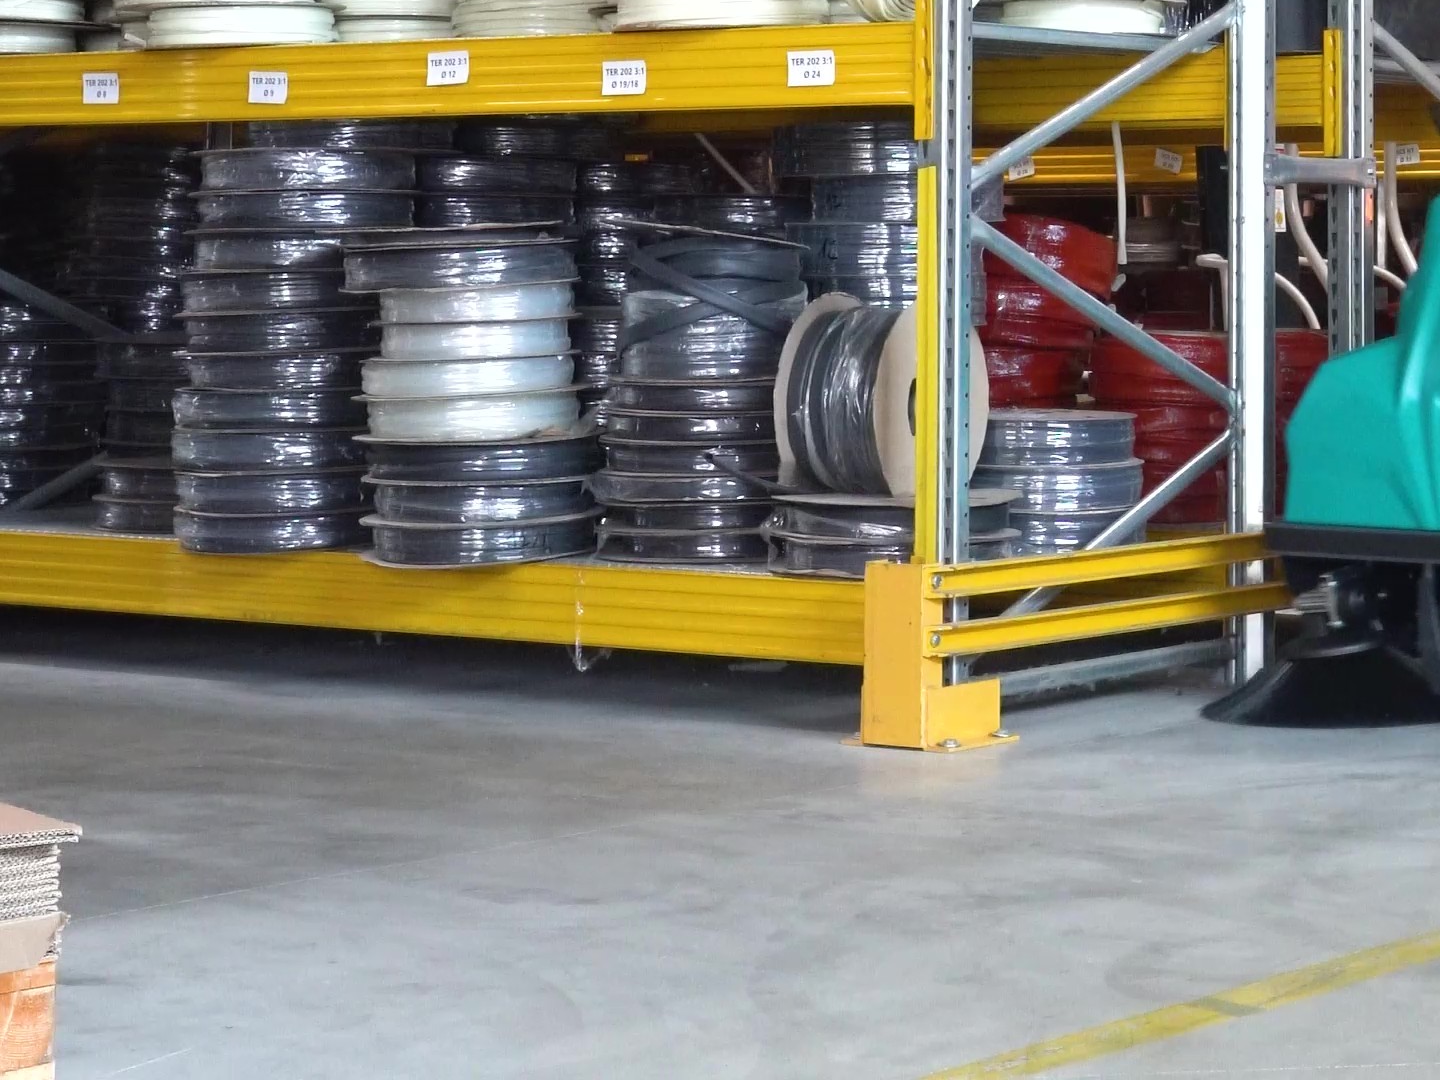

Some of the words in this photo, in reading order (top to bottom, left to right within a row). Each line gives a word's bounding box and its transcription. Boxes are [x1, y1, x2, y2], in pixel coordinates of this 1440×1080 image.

[431, 59, 443, 67] TER
[444, 58, 456, 67] 202
[458, 58, 468, 66] 3:1
[791, 58, 805, 66] TER
[806, 57, 820, 65] 202
[822, 56, 833, 65] 3:1
[448, 70, 456, 79] 12
[606, 68, 619, 77] TER
[620, 67, 633, 76] 202
[634, 67, 645, 75] 3:1
[811, 70, 821, 79] 24
[85, 79, 97, 87] TER
[97, 79, 108, 87] 202
[252, 77, 264, 85] TER
[264, 77, 276, 85] 202
[277, 77, 286, 85] 3:1
